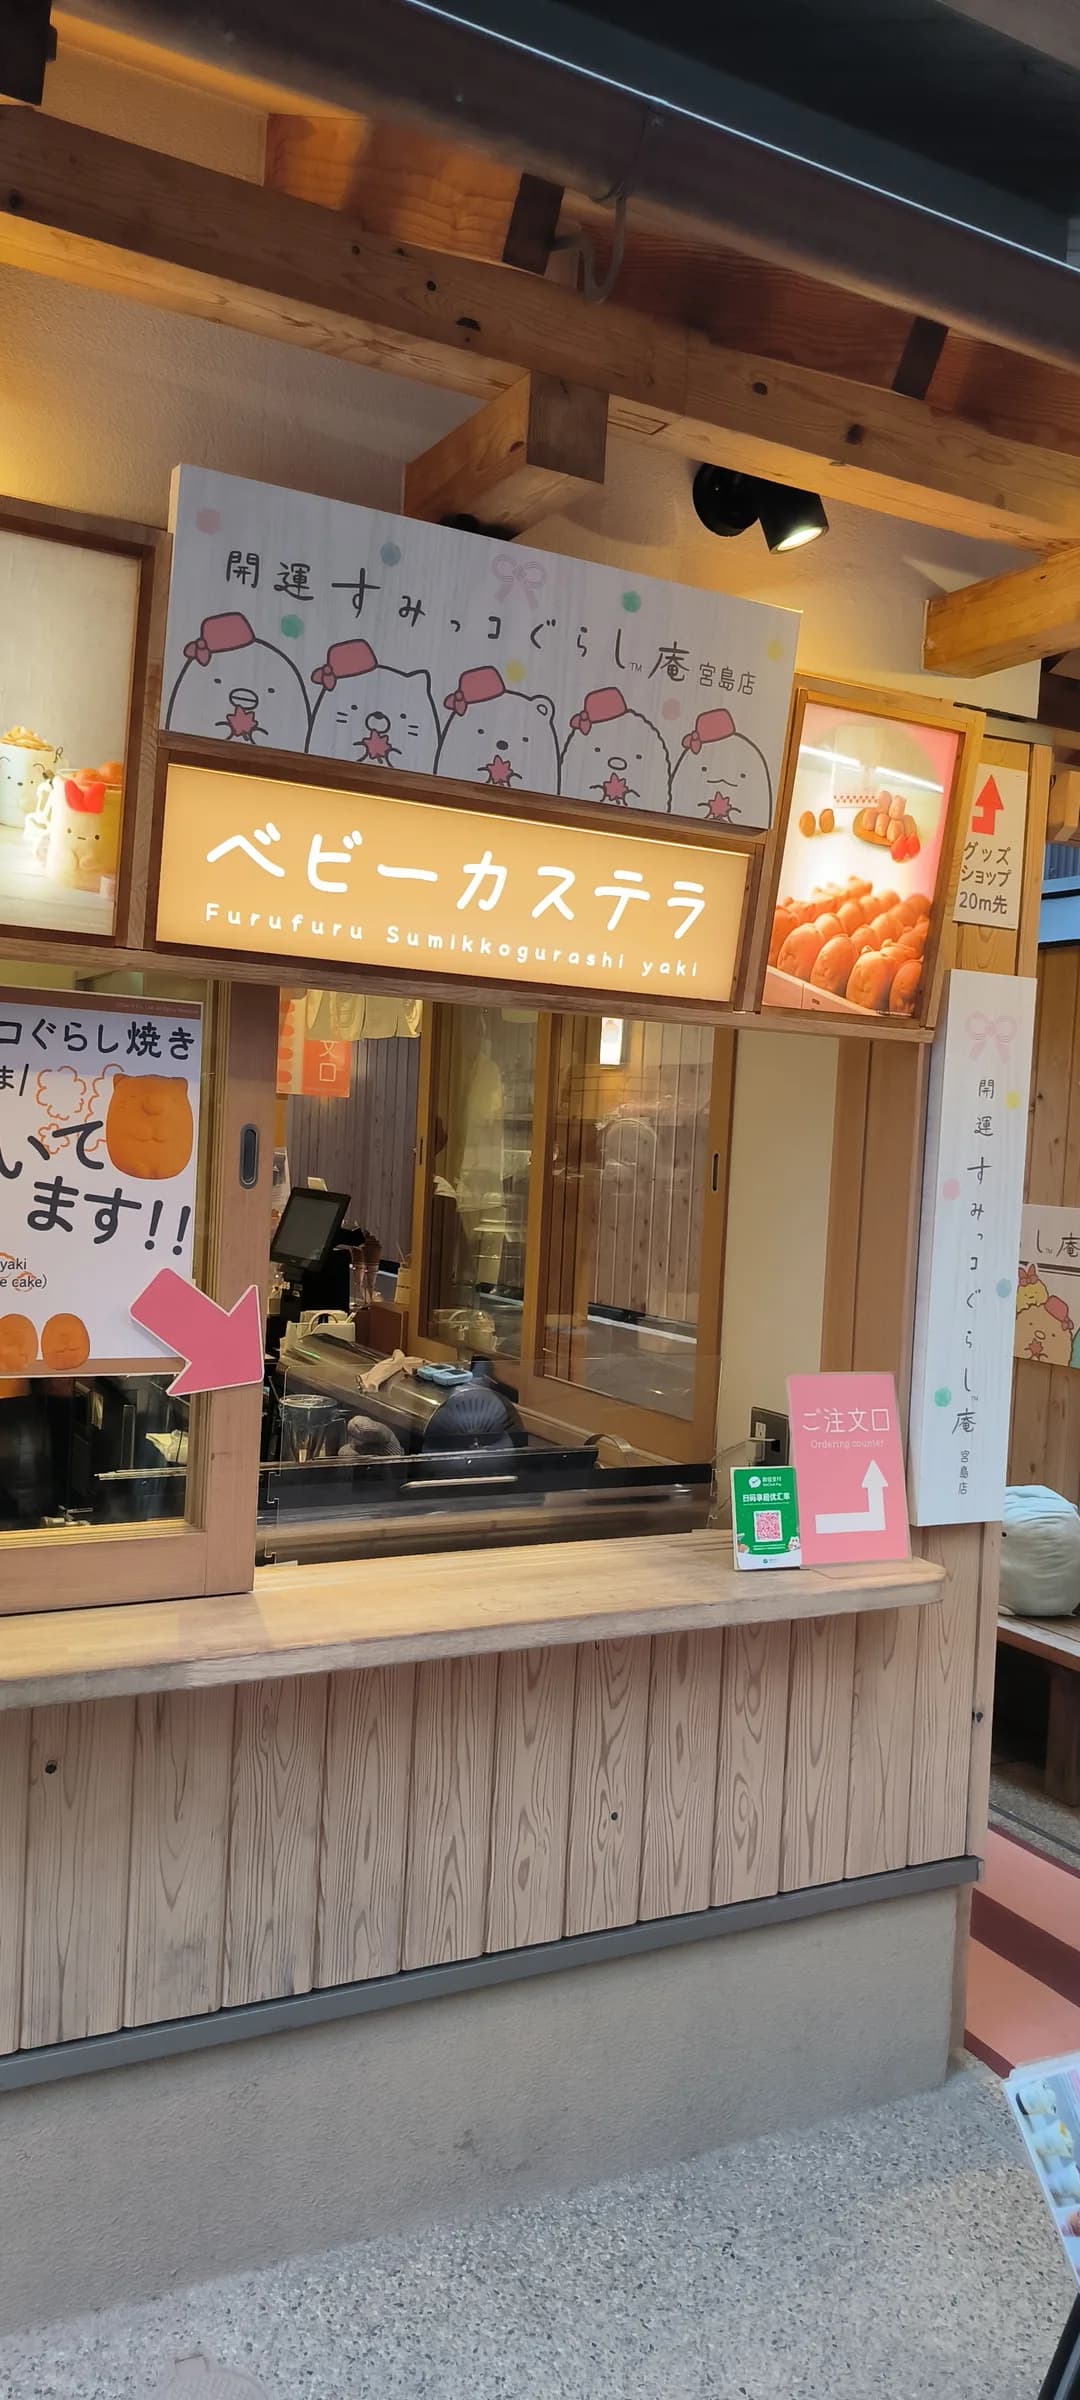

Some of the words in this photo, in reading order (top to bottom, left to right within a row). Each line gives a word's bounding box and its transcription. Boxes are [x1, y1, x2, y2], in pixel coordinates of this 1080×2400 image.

[699, 662, 757, 696] 宮島店
[963, 841, 1011, 866] グッズ
[206, 822, 706, 941] ベビーカステラ
[960, 864, 1012, 887] ショップ
[958, 891, 1008, 915] 20m先
[205, 903, 364, 941] Furufuru
[386, 925, 625, 970] Sumikkogurashi
[642, 959, 698, 978] yaki
[0, 1018, 195, 1060] コぐらし焼き
[27, 1175, 191, 1256] ます!!
[0, 1257, 27, 1272] yaki
[12, 1273, 47, 1289] cake)
[802, 1407, 890, 1433] ご注文口
